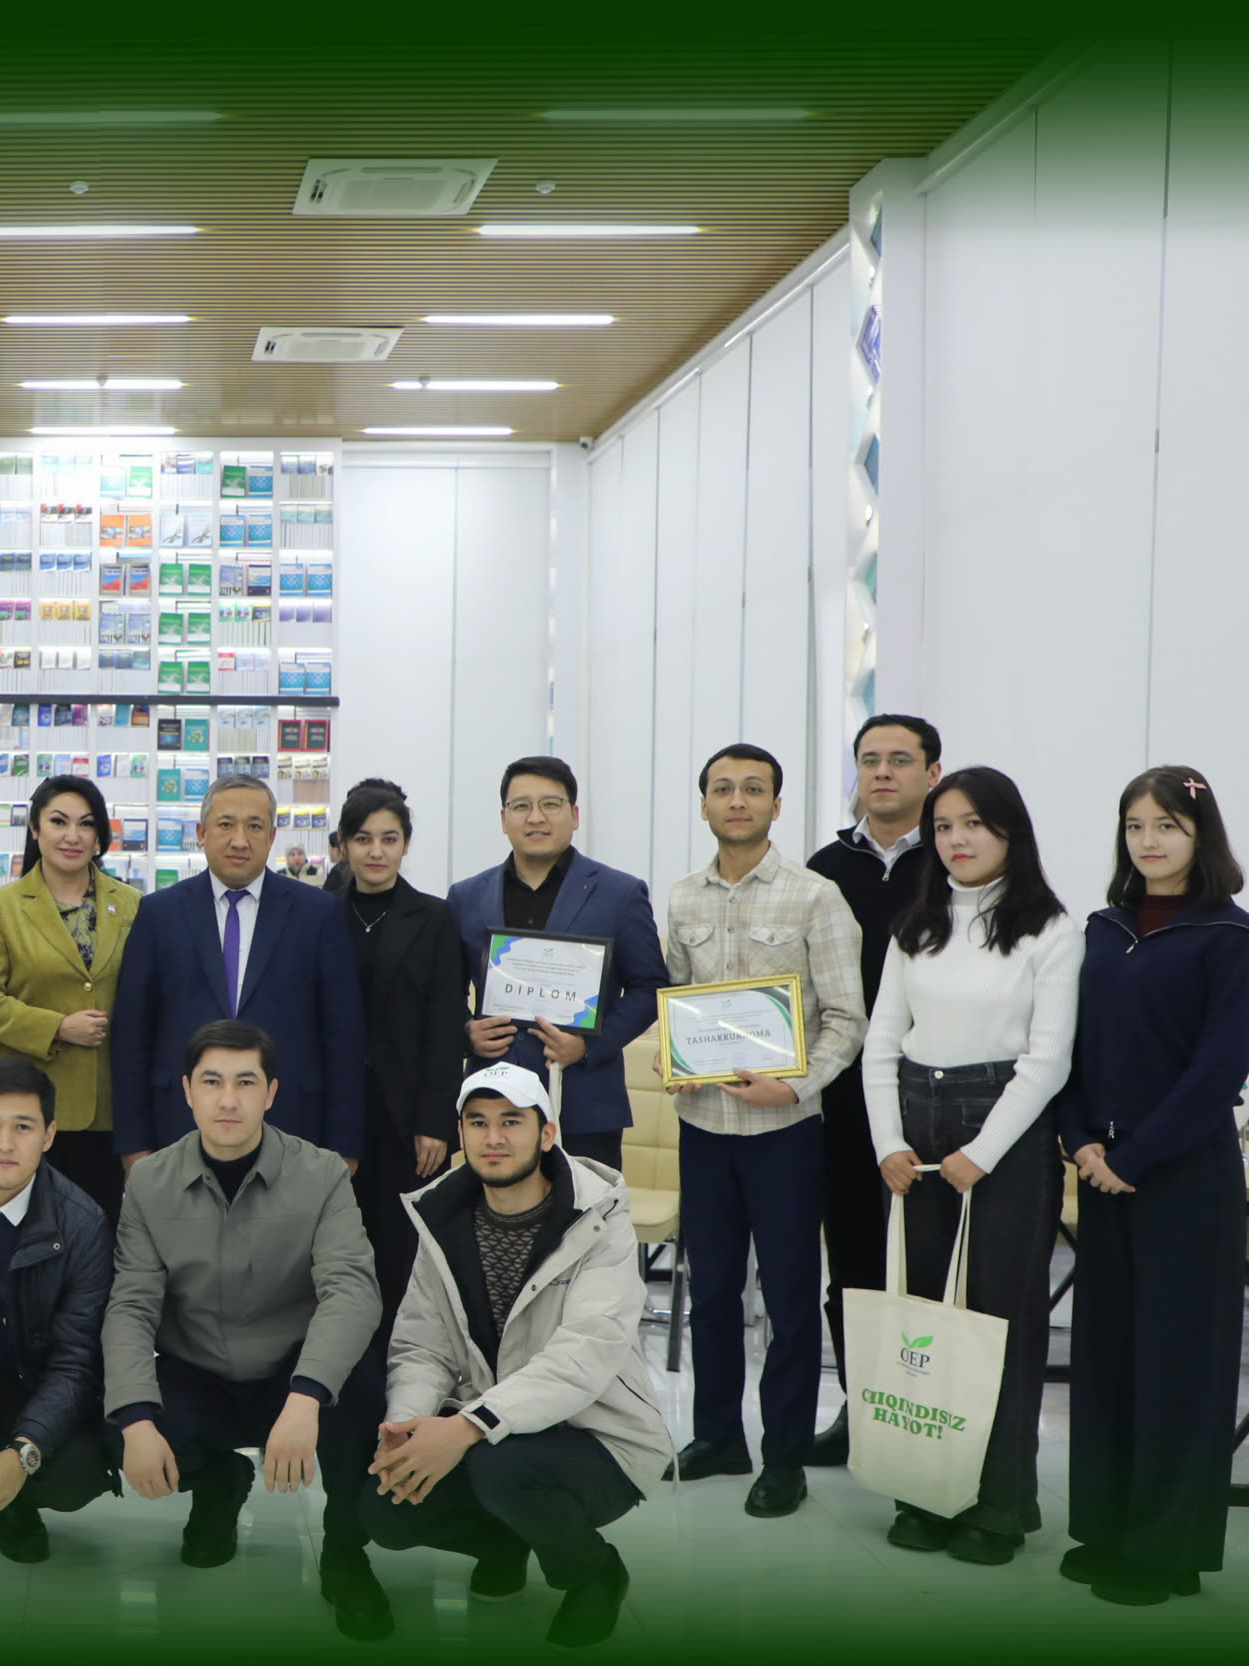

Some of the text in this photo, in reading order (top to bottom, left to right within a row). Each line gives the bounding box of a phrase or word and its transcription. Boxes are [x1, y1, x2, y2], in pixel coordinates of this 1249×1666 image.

[505, 983, 577, 1002] DIPLOM
[900, 1347, 930, 1369] OEP
[873, 1406, 943, 1440] HAYOT!
